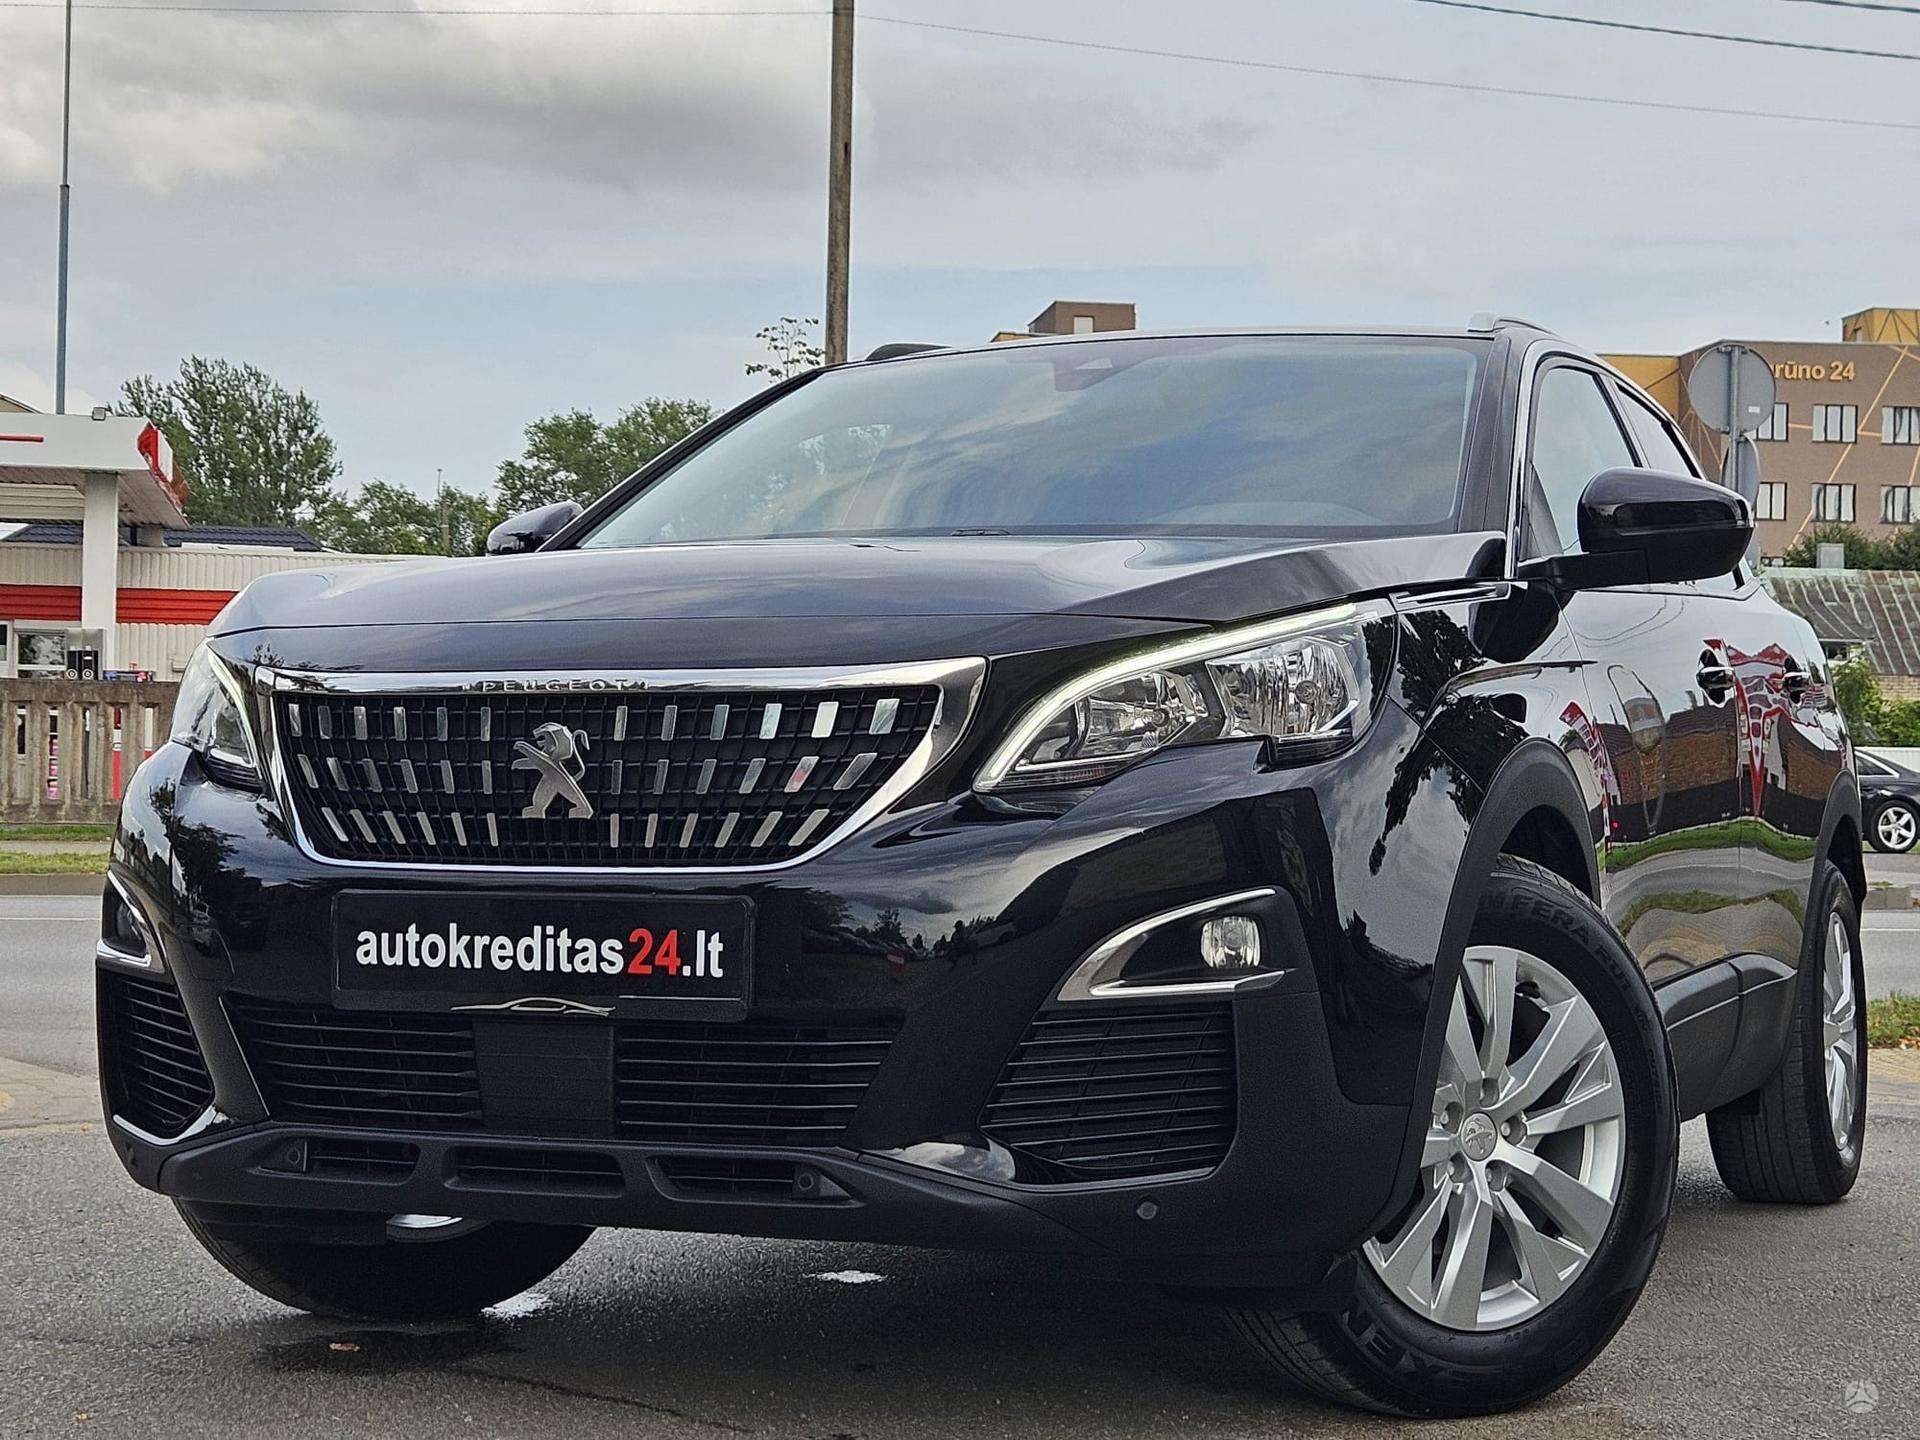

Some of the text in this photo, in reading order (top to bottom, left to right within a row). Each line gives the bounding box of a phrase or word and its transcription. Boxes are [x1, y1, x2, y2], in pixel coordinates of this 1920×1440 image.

[1770, 360, 1856, 381] rūno 24
[482, 678, 629, 692] PEUGEOT
[355, 922, 724, 978] autokreditas24.lt
